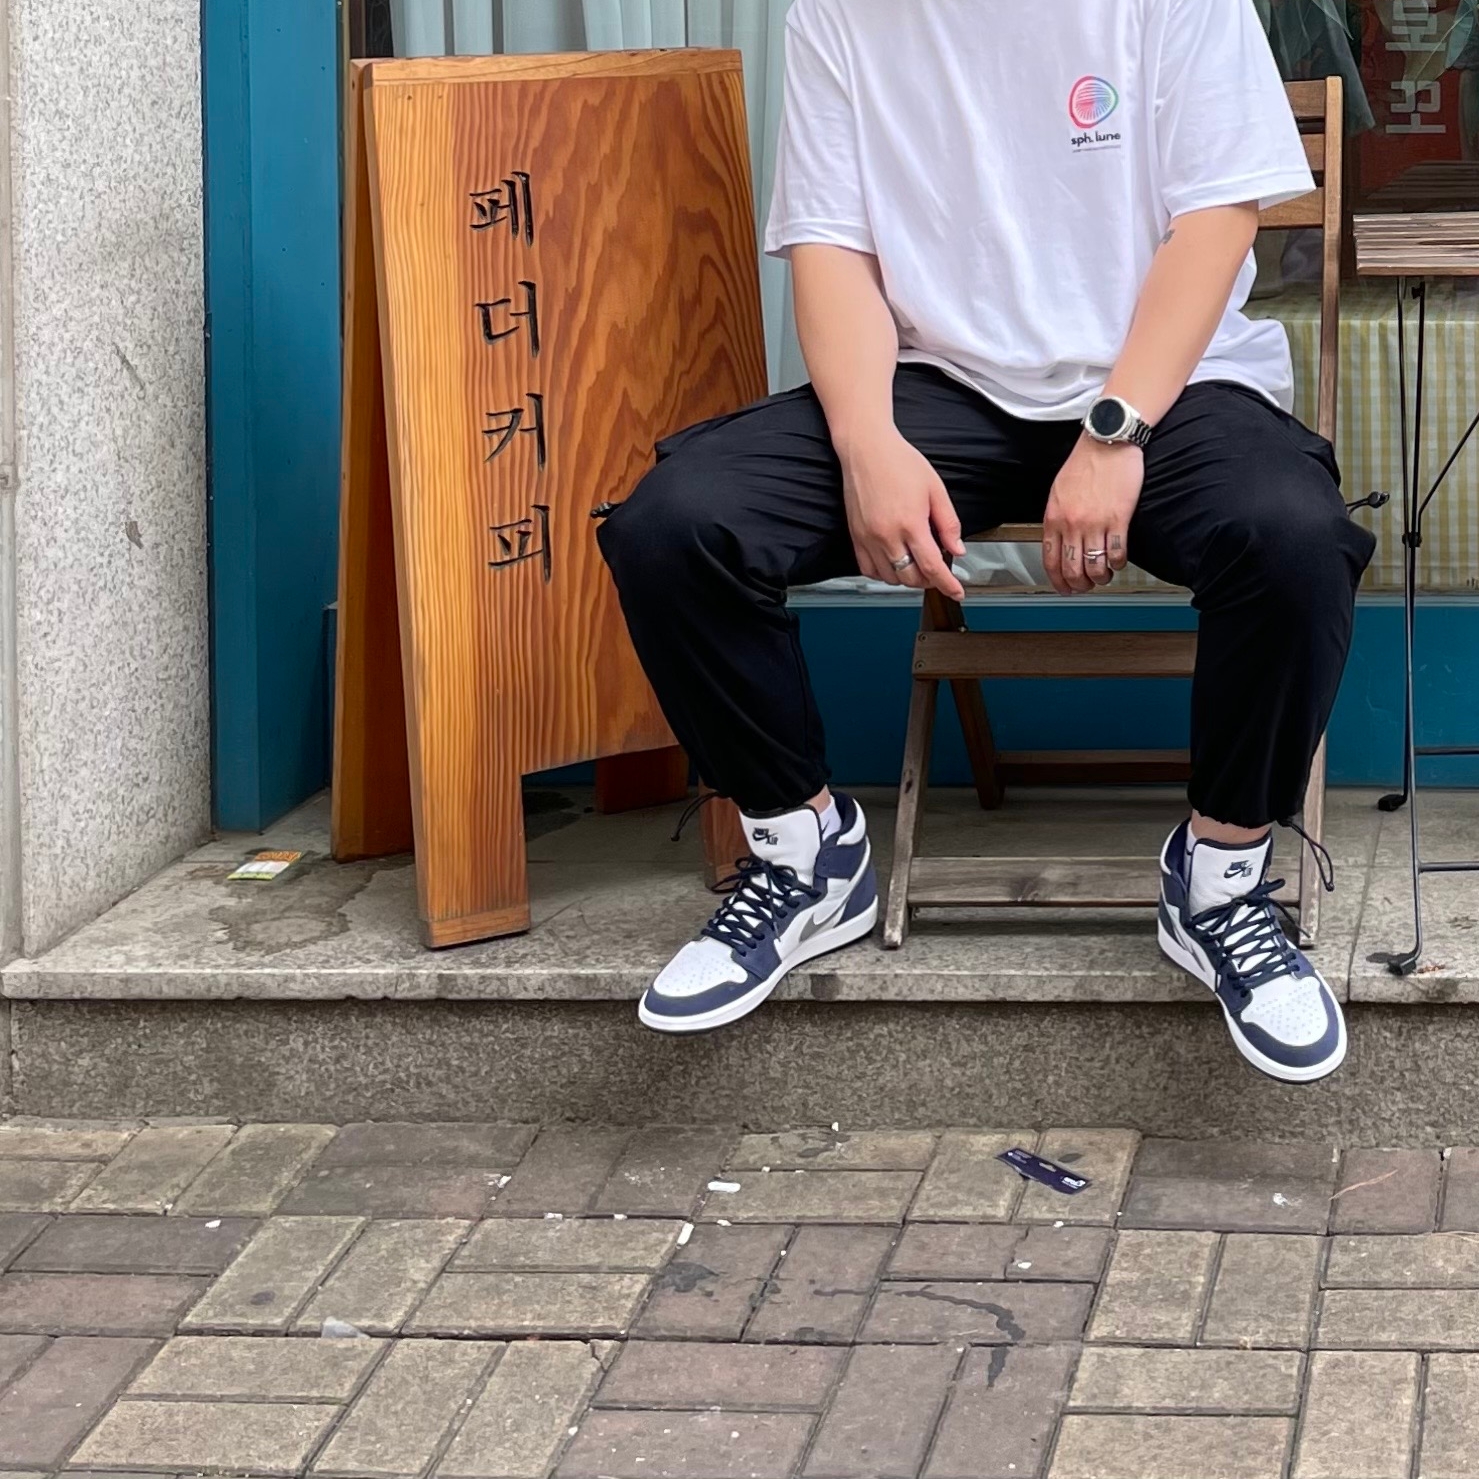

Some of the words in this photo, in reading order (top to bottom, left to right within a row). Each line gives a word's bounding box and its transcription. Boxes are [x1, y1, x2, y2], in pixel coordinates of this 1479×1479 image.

[1071, 131, 1094, 147] sph.
[1095, 130, 1121, 143] lune
[469, 170, 552, 584] 페더커피
